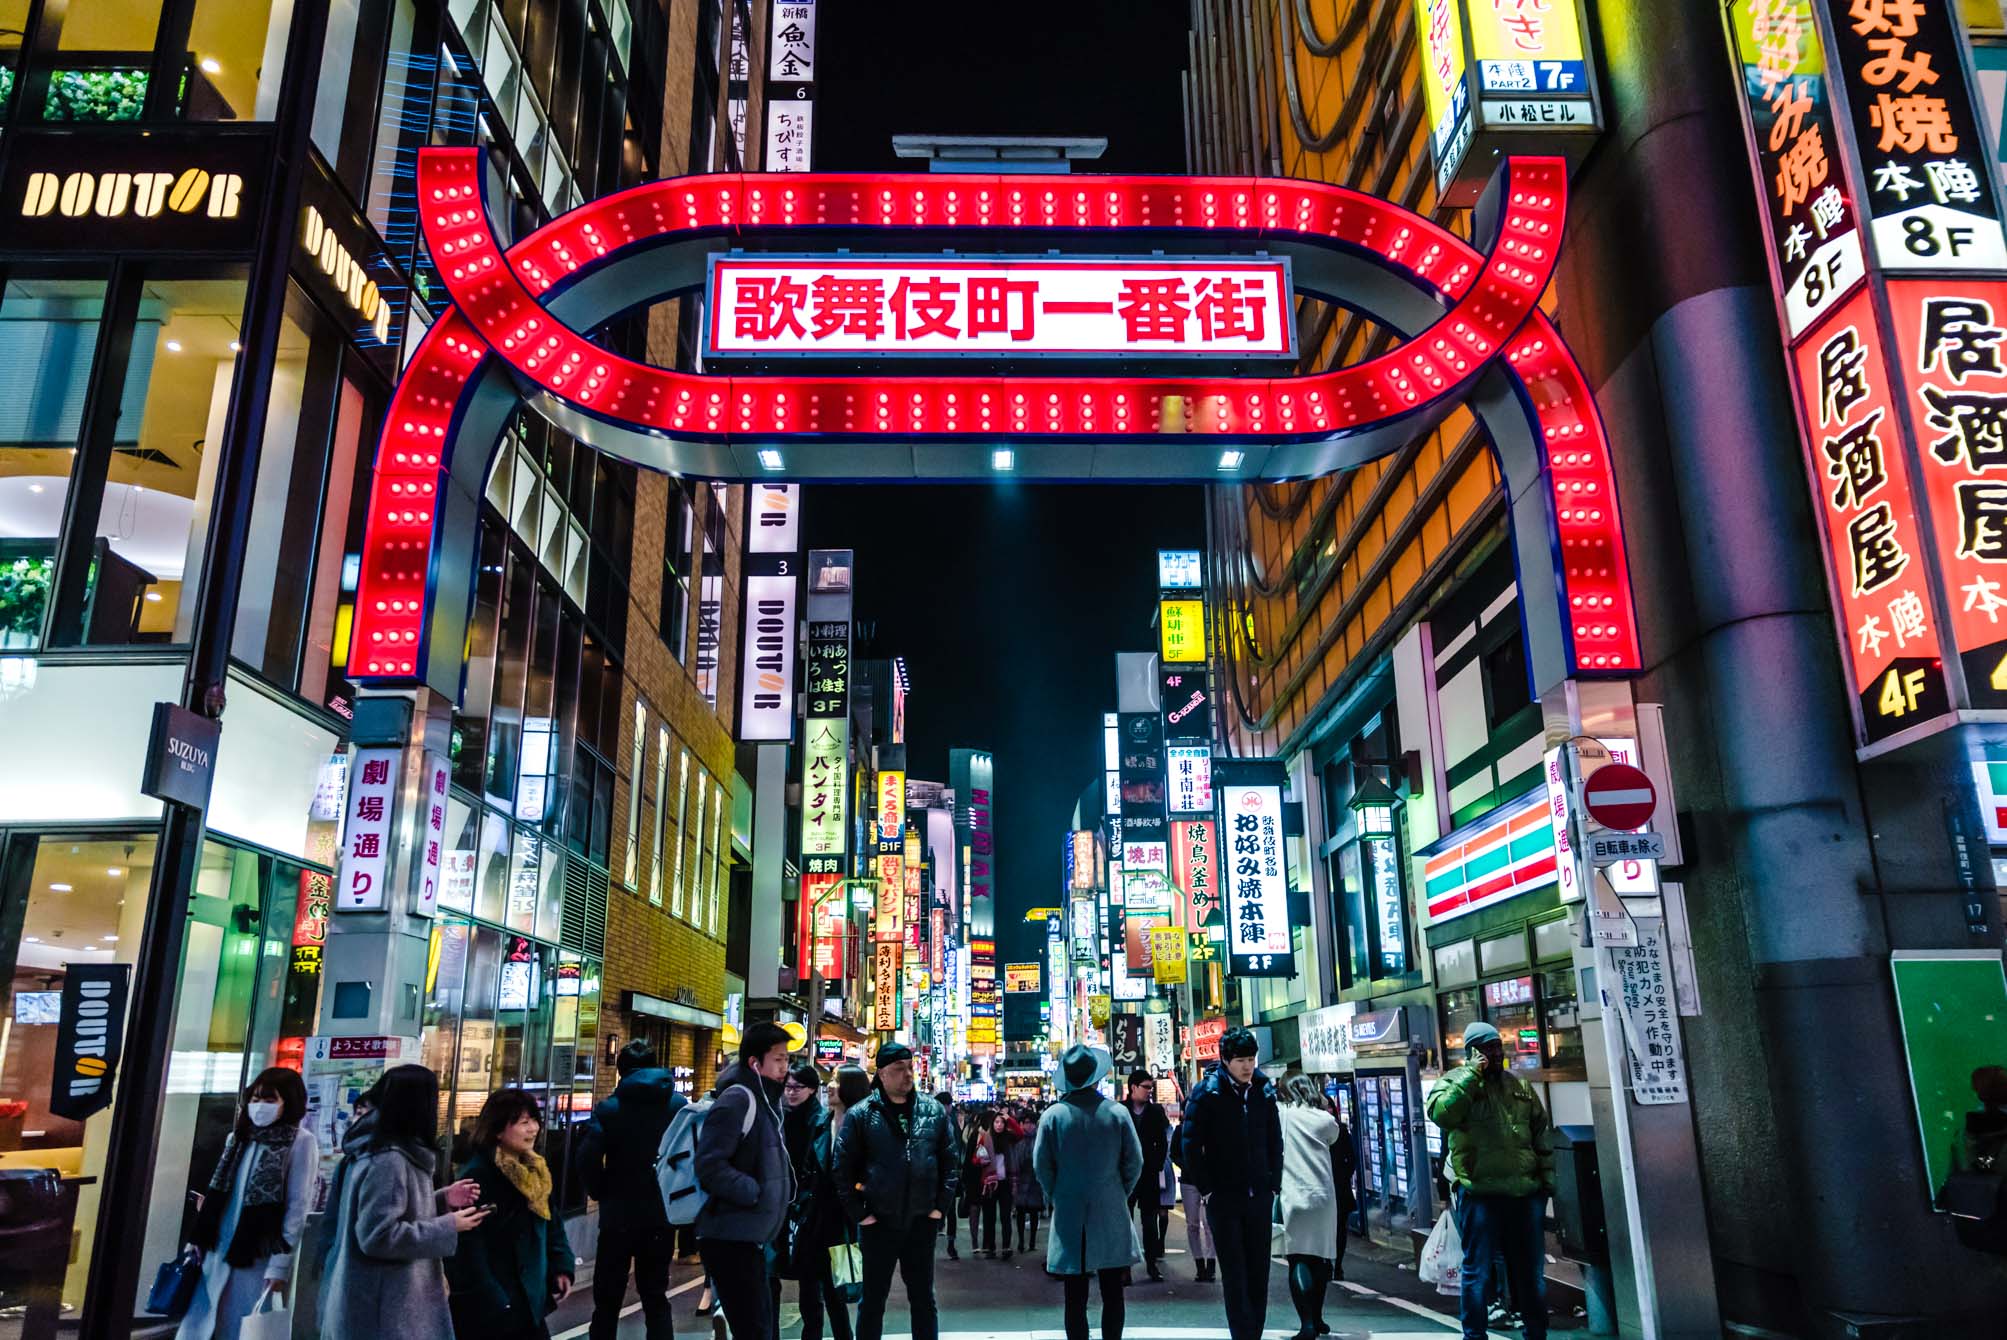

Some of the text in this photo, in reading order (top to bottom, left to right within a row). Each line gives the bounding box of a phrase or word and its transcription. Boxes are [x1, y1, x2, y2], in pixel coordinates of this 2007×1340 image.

[782, 7, 808, 19] 新橋
[777, 22, 811, 76] 魚金
[796, 87, 806, 99] 6
[1539, 62, 1575, 89] 7F
[1499, 103, 1576, 122] 小松ビル
[21, 167, 243, 218] DOUTOR
[1873, 158, 1981, 204] 本陣
[1784, 184, 1844, 263] 本陣
[1902, 216, 1974, 257] 8F
[303, 205, 391, 344] DOUTOR
[1804, 249, 1842, 308] 8F
[734, 275, 1267, 342] 歌舞伎町一番街
[1917, 296, 2007, 562] 居酒屋
[1818, 325, 1910, 600] 居酒屋
[778, 560, 788, 575] 3
[810, 624, 847, 639] 小料理
[1857, 589, 1928, 659] 本陣
[754, 599, 785, 710] DOUTOR
[809, 645, 822, 693] いろは
[1168, 649, 1183, 659] 5F
[812, 700, 842, 712] 3F
[1166, 676, 1182, 687] 4F
[1878, 667, 1926, 718] 4F
[168, 736, 209, 769] SUZUYA
[810, 756, 831, 827] バンタイ
[352, 759, 390, 896] 劇場通り
[424, 769, 447, 901] 劇場通り
[880, 841, 902, 852] B1F
[1594, 839, 1660, 857] 自転車を除く
[809, 859, 838, 873] 焼肉
[1187, 823, 1209, 929] 焼鳥釜めし
[1233, 813, 1266, 944] お好み焼本陣
[1192, 947, 1215, 960] 2F
[1248, 955, 1273, 970] 2F
[1633, 945, 1666, 1074] 防犯カメラ作動中
[1646, 936, 1678, 1081] みなさまの安全を守ります
[69, 980, 112, 1098] DOUTOR
